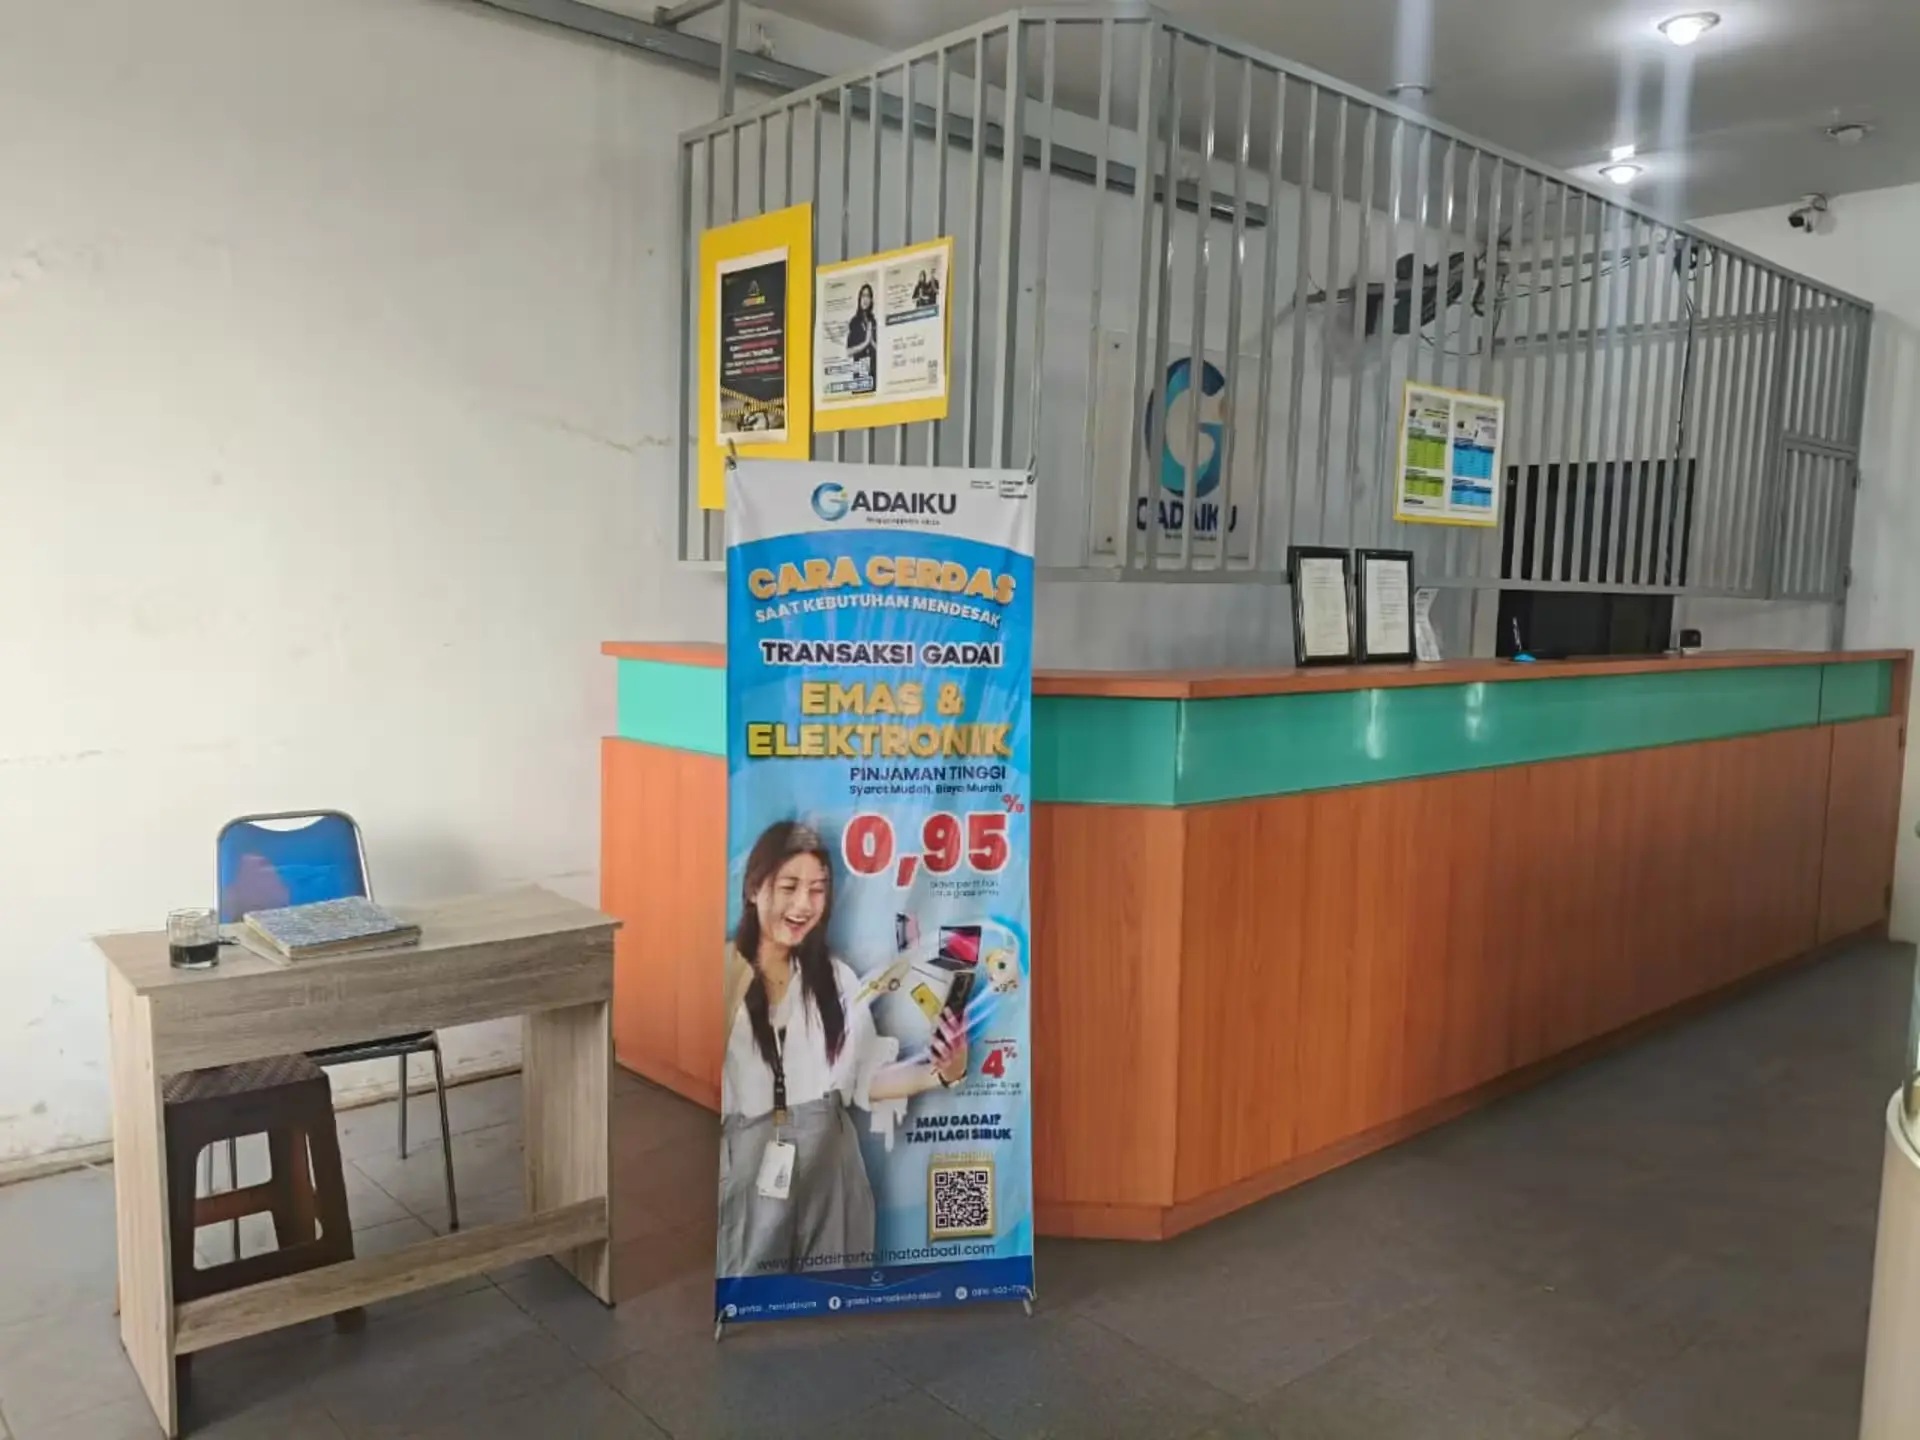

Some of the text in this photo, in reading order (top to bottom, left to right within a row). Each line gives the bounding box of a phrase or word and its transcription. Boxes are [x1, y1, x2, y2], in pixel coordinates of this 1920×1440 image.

[748, 555, 1016, 605] CARA CERDAS
[756, 594, 1000, 628] SAAT KEBUTUHAN MENDESAK
[761, 641, 1000, 665] TRANSAKSI GADAI
[801, 681, 964, 716] EMAS &
[747, 723, 1013, 758] ELEKTRONIK
[850, 765, 1006, 781] PINJAMAN TINGGI
[966, 782, 1003, 793] Murah
[916, 1113, 1002, 1128] MAU GADAI?
[906, 1128, 1011, 1144] TAPI LAGI SIBUK
